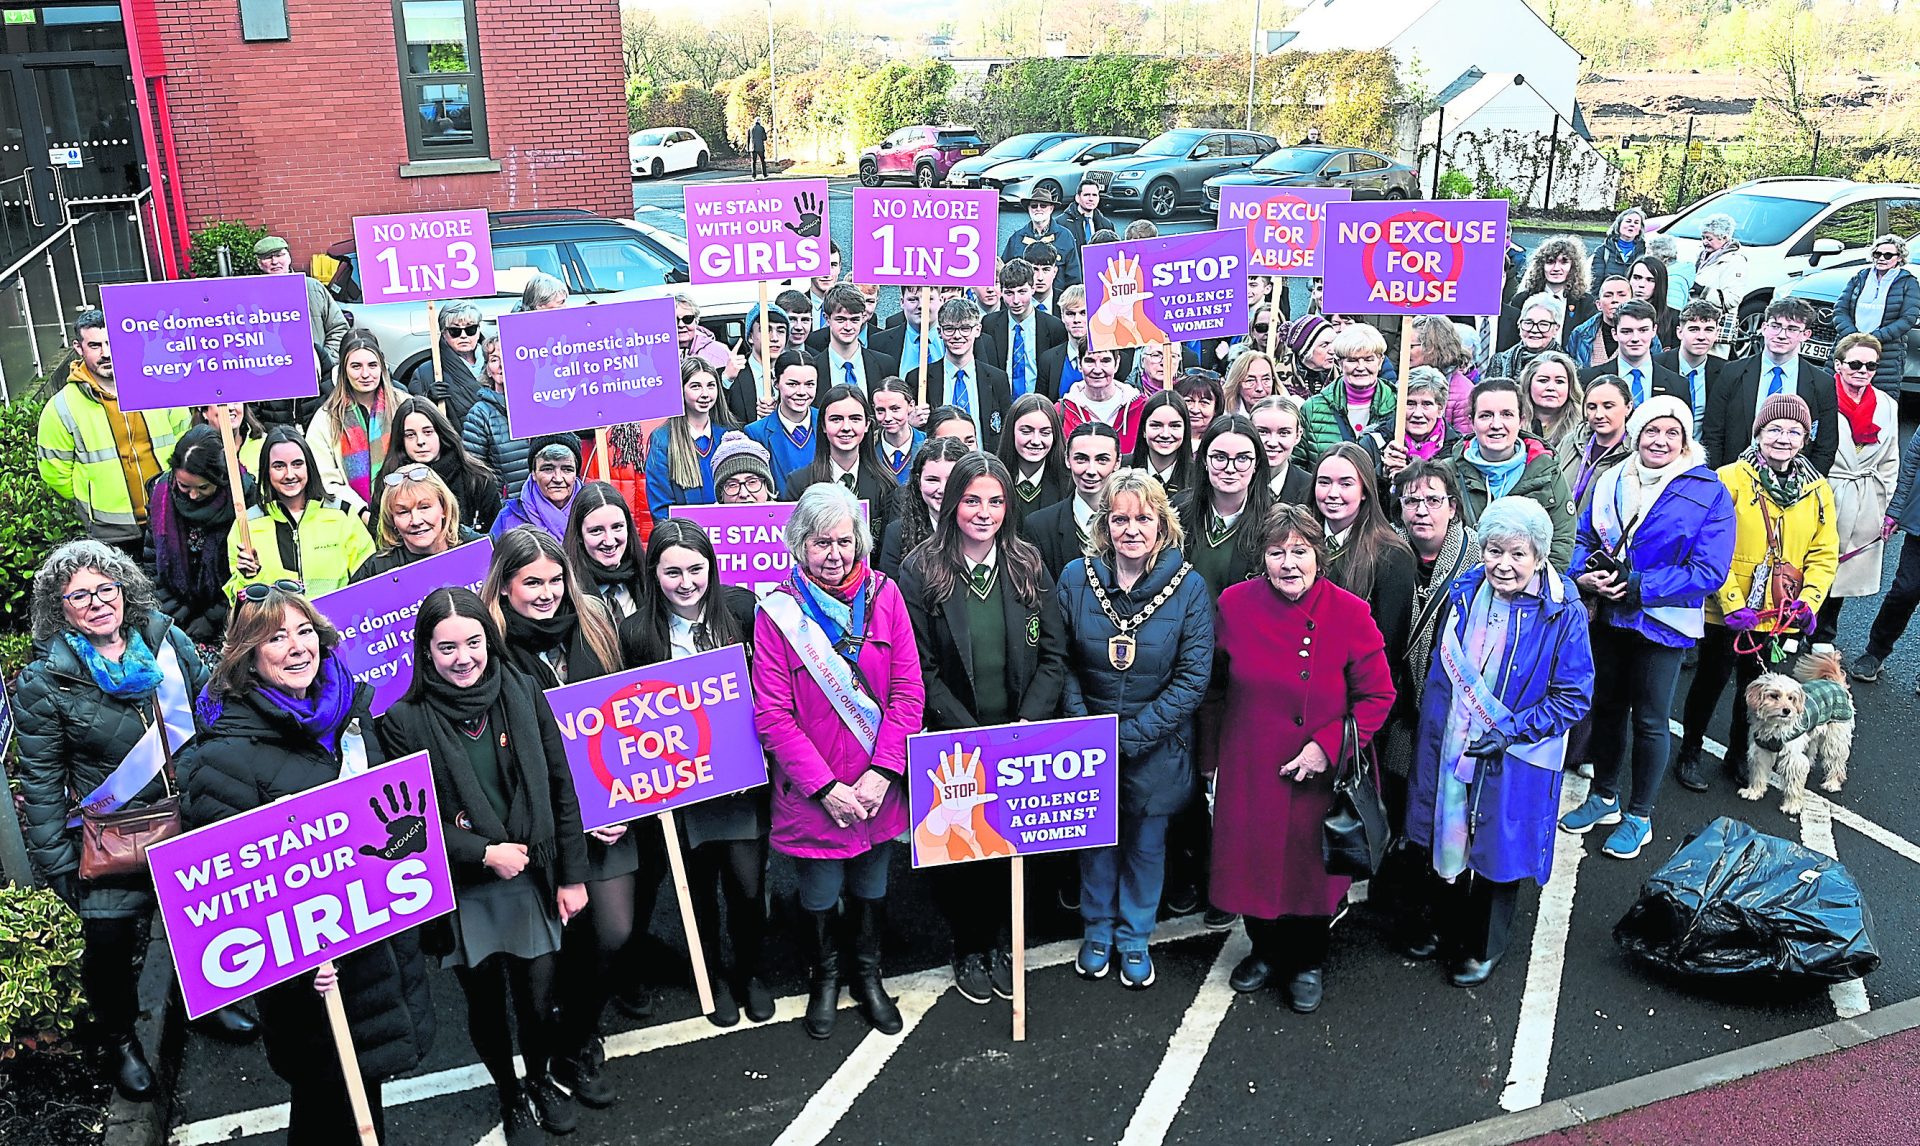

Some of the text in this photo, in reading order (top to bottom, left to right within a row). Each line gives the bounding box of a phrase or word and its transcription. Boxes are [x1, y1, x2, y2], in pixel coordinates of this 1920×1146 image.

[694, 198, 783, 216] WE STAND
[872, 199, 979, 220] NO MORE
[1229, 202, 1262, 220] NO
[372, 219, 473, 242] NO MORE
[696, 219, 783, 237] WITH OUR
[1264, 225, 1304, 244] FOR
[1338, 220, 1497, 244] NO EXCUSE
[699, 238, 821, 278] GIRLS
[1249, 248, 1315, 267] ABUSE
[1386, 250, 1442, 273] FOR
[1152, 255, 1240, 287] STOP
[1111, 282, 1136, 296] STOP
[1160, 288, 1234, 306] VIOLENCE
[1368, 280, 1458, 303] ABUSE
[121, 309, 300, 332] One domestic abuse
[1163, 302, 1233, 320] AGAINST
[1172, 317, 1225, 333] WOMEN
[166, 332, 264, 352] call to PSNI
[515, 331, 670, 360] One domestic abuse
[142, 354, 292, 377] every 16 minutes
[553, 354, 639, 378] call to PSNI
[532, 375, 663, 404] every 16 minutes
[702, 526, 787, 544] E STAN
[716, 554, 747, 572] TH
[337, 626, 356, 641] ne
[367, 632, 399, 656] call
[402, 652, 414, 666] 1
[804, 643, 820, 663] HER
[840, 695, 857, 714] OUR
[555, 671, 740, 741] NO EXCUSE
[1463, 685, 1477, 705] OUR
[1474, 704, 1497, 729] PRIOR
[618, 724, 690, 766] FOR
[996, 748, 1107, 788] STOP
[608, 754, 714, 808] ABUSE
[944, 782, 976, 800] STOP
[1006, 788, 1100, 811] VIOLENCE
[1010, 806, 1098, 828] AGAINST
[384, 820, 424, 858] ENOUGH
[1020, 824, 1088, 844] WOMEN
[174, 811, 350, 892] WE STAND
[182, 846, 356, 928] WITH OUR
[200, 858, 434, 989] GIRLS
